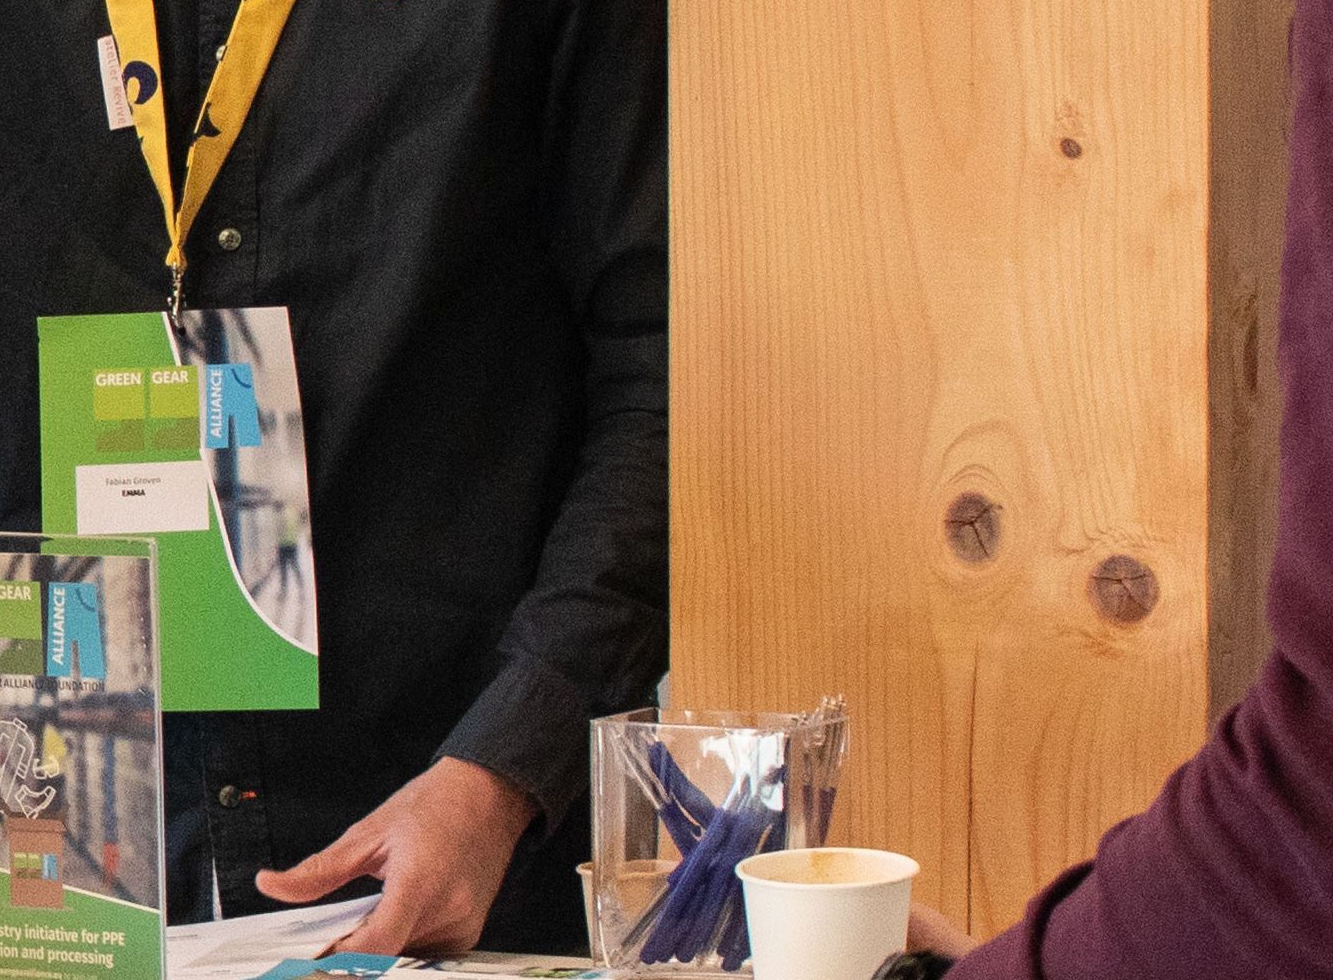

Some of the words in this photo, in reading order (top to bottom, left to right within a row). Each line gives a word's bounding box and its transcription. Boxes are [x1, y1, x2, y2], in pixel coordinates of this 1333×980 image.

[95, 372, 142, 387] GREEN
[152, 370, 190, 385] GEAR
[210, 368, 224, 439] ALLIANCE
[51, 587, 66, 665] ALLIANCE
[25, 924, 79, 943] initiative
[81, 928, 100, 944] for
[102, 931, 126, 946] PPE
[21, 946, 45, 960] and
[47, 950, 115, 969] processing
